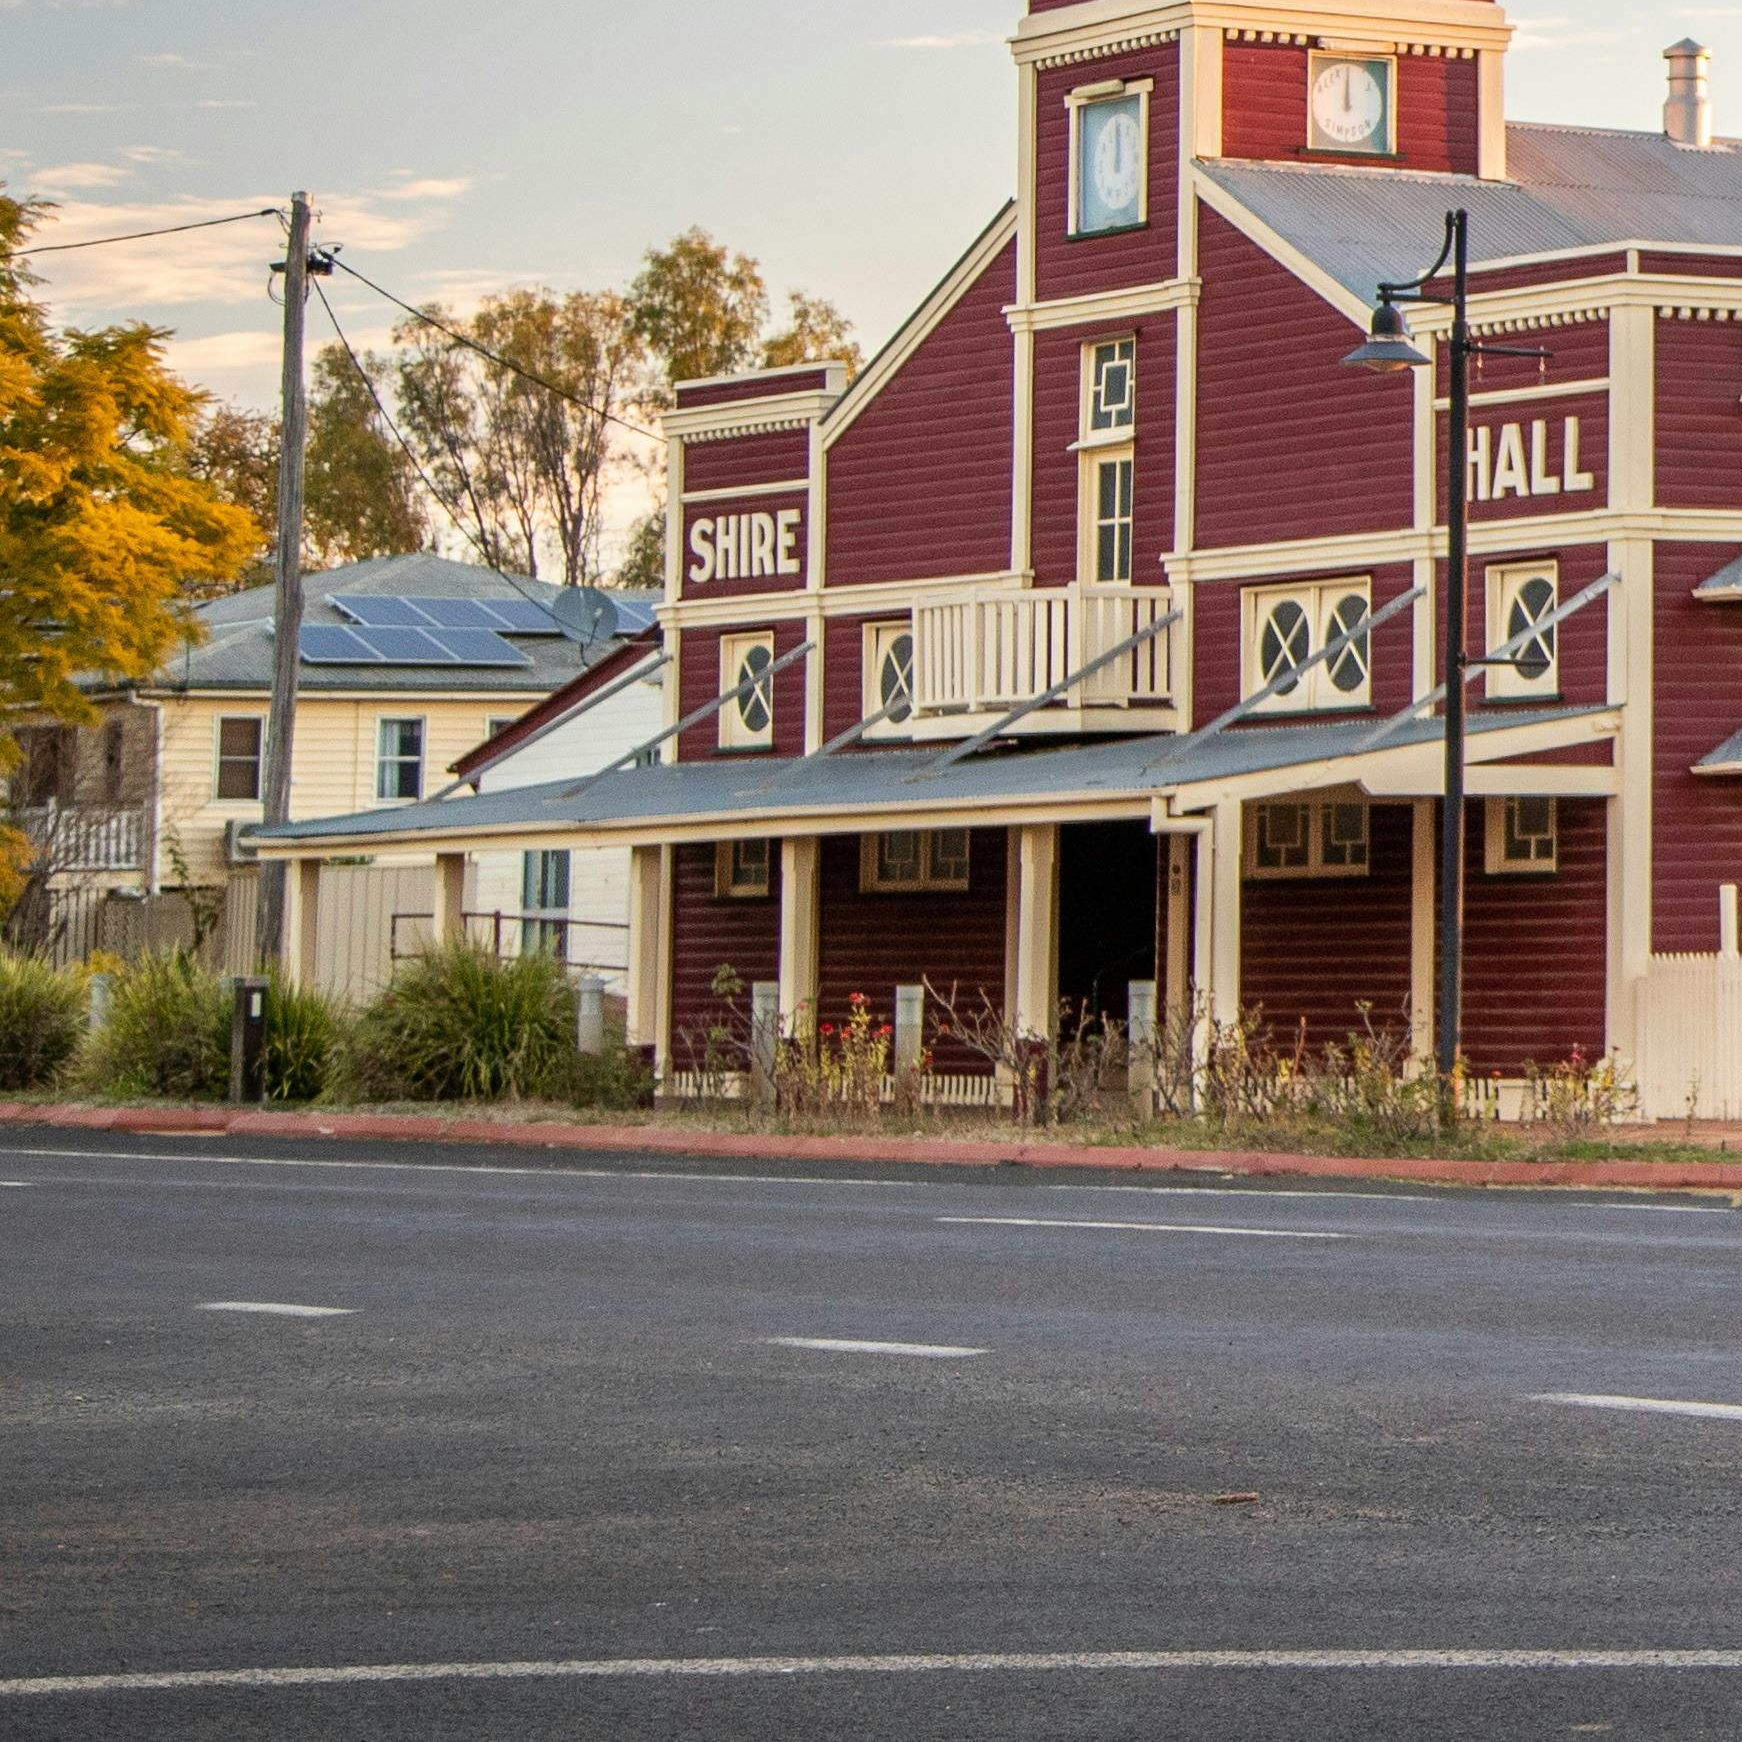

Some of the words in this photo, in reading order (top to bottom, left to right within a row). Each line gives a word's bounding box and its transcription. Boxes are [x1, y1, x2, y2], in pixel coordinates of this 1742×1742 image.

[1324, 117, 1372, 139] SIMPSON
[1466, 415, 1595, 503] HALL
[688, 508, 802, 584] SHIRE
